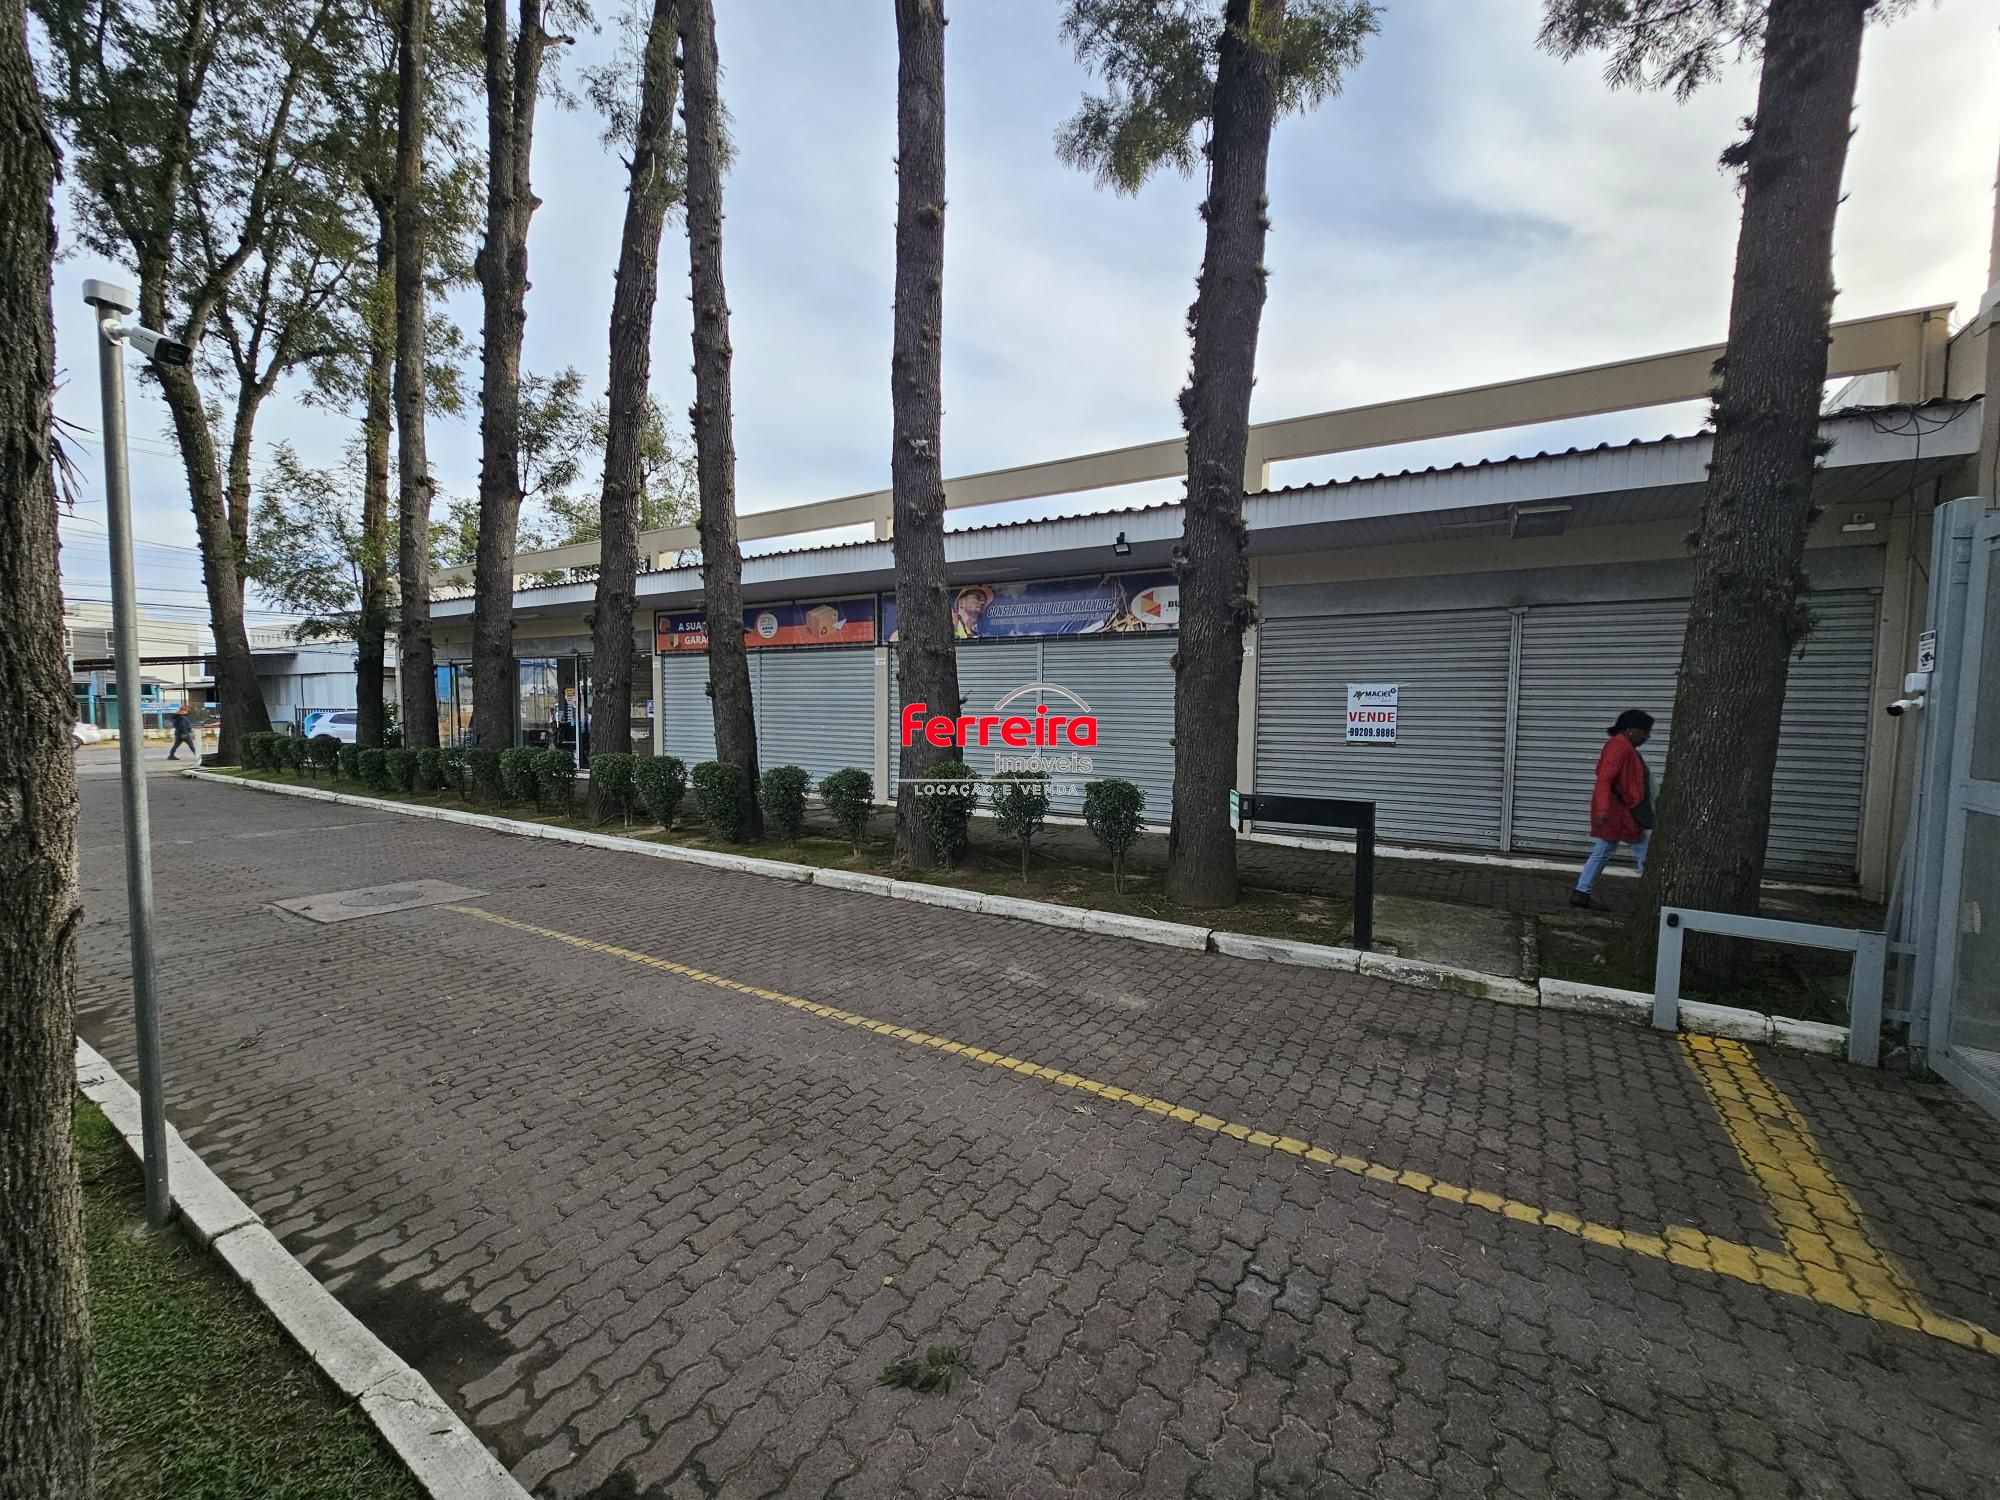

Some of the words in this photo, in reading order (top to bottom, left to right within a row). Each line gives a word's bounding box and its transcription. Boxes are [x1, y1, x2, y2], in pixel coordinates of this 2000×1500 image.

[987, 603, 1039, 617] CONSTRUINDO
[1040, 603, 1052, 615] OU
[678, 622, 685, 631] A
[685, 621, 702, 631] SUA
[1348, 711, 1395, 722] VENDE
